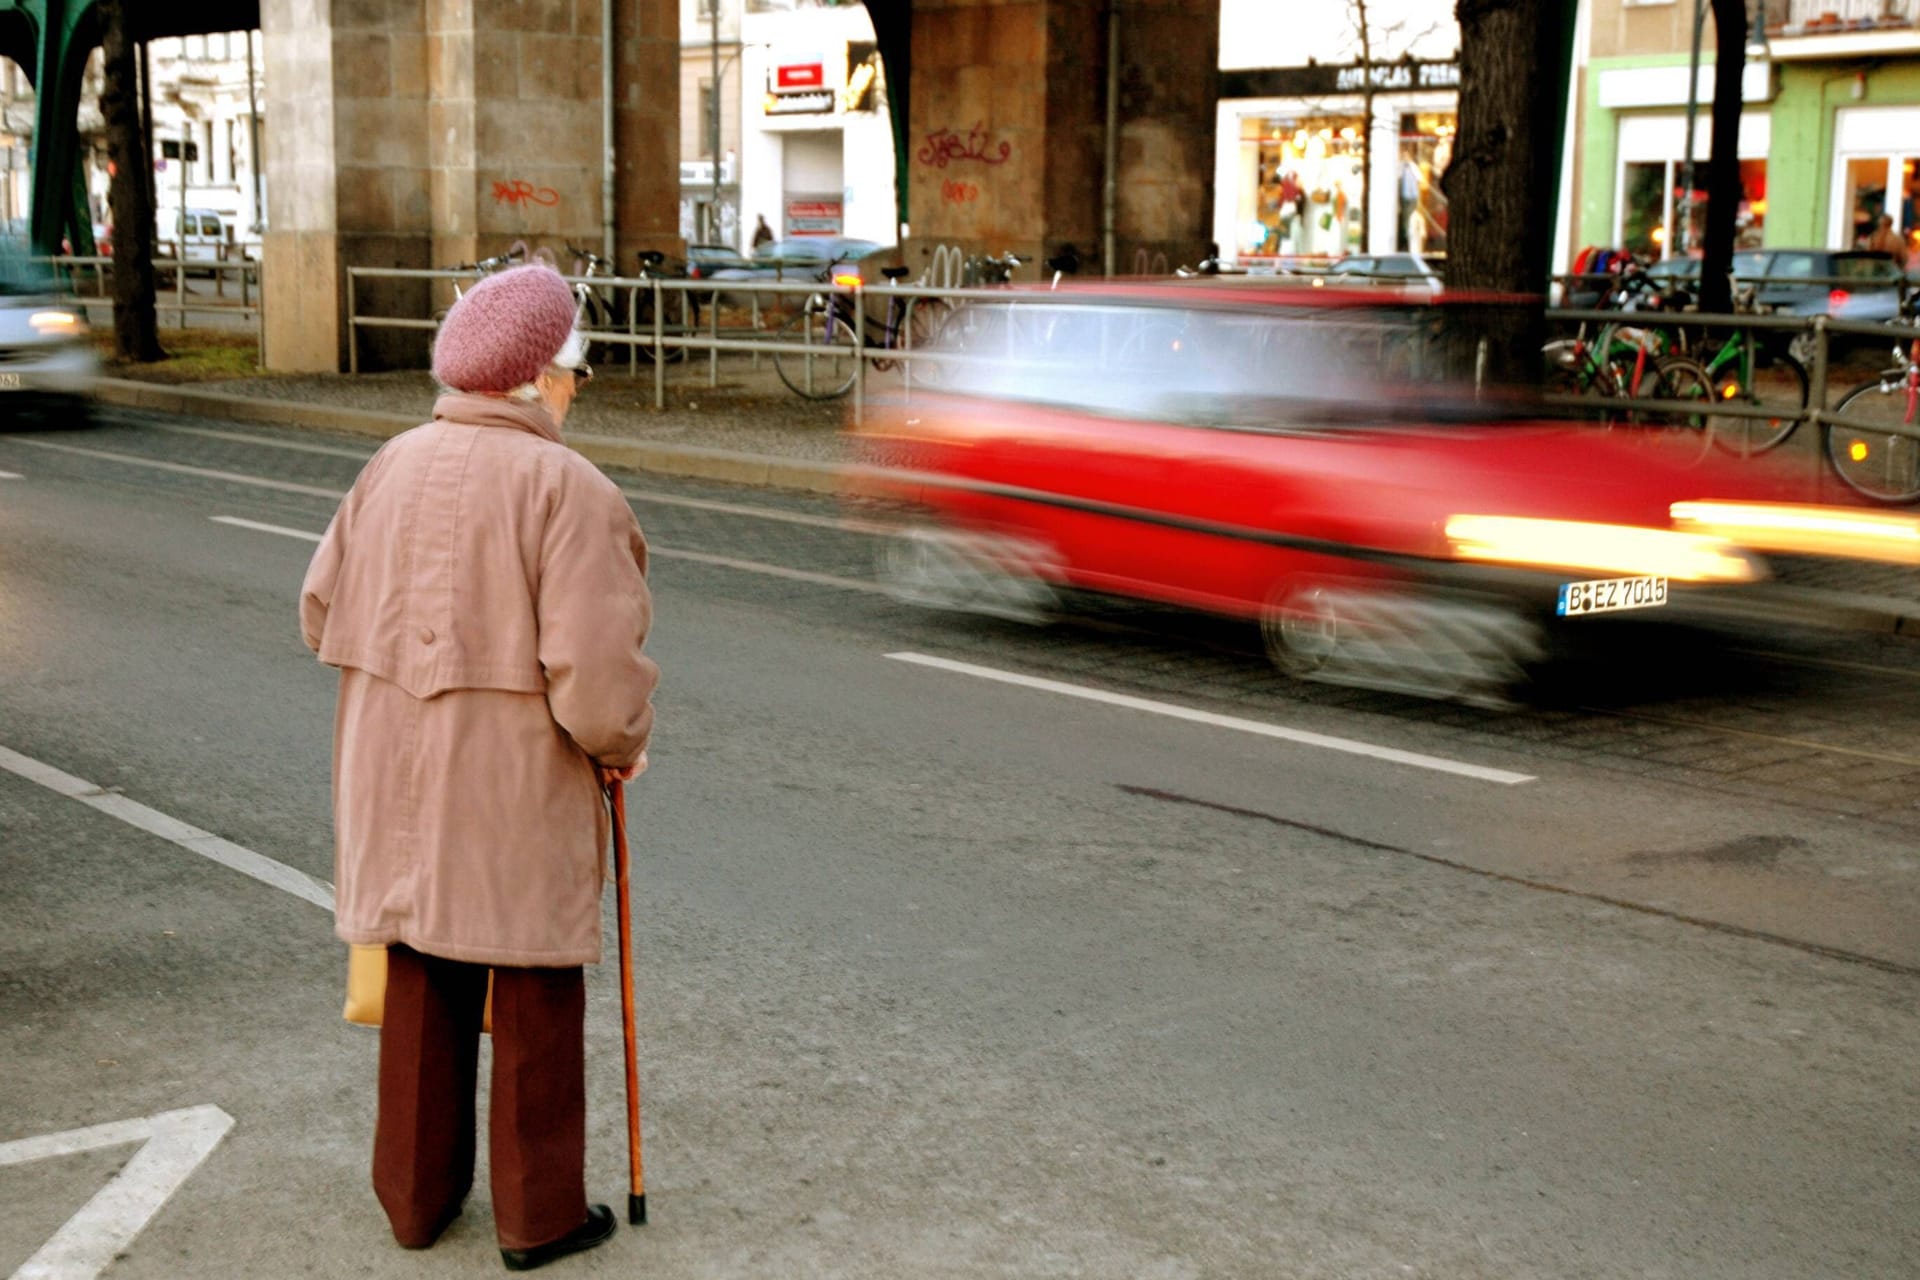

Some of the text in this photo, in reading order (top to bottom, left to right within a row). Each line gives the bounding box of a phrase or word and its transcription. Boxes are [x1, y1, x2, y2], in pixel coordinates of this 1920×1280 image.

[1570, 577, 1665, 611] B EZ 7015
